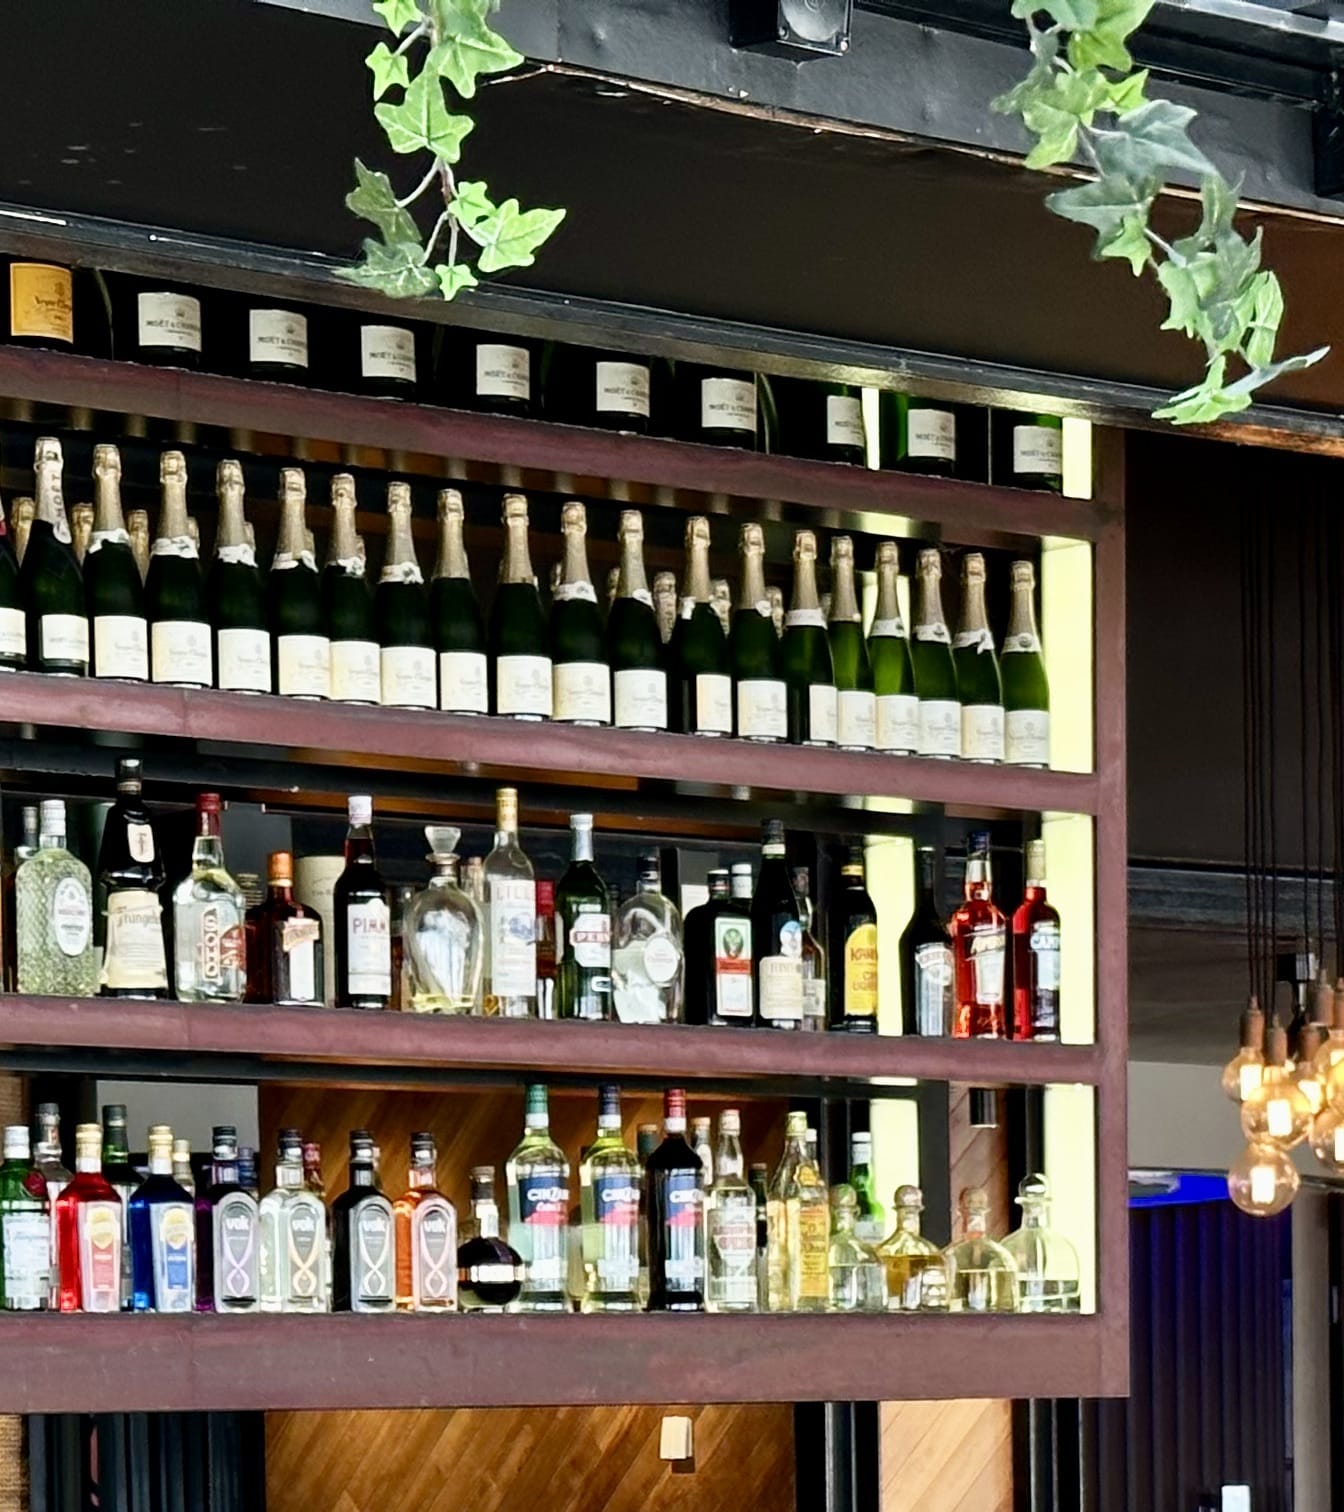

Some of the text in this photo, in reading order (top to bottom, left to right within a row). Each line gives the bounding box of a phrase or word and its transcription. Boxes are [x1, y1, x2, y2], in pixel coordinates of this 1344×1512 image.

[225, 1216, 250, 1231] vok
[292, 1216, 315, 1231] vok
[362, 1216, 387, 1232] vok
[422, 1217, 449, 1232] vok
